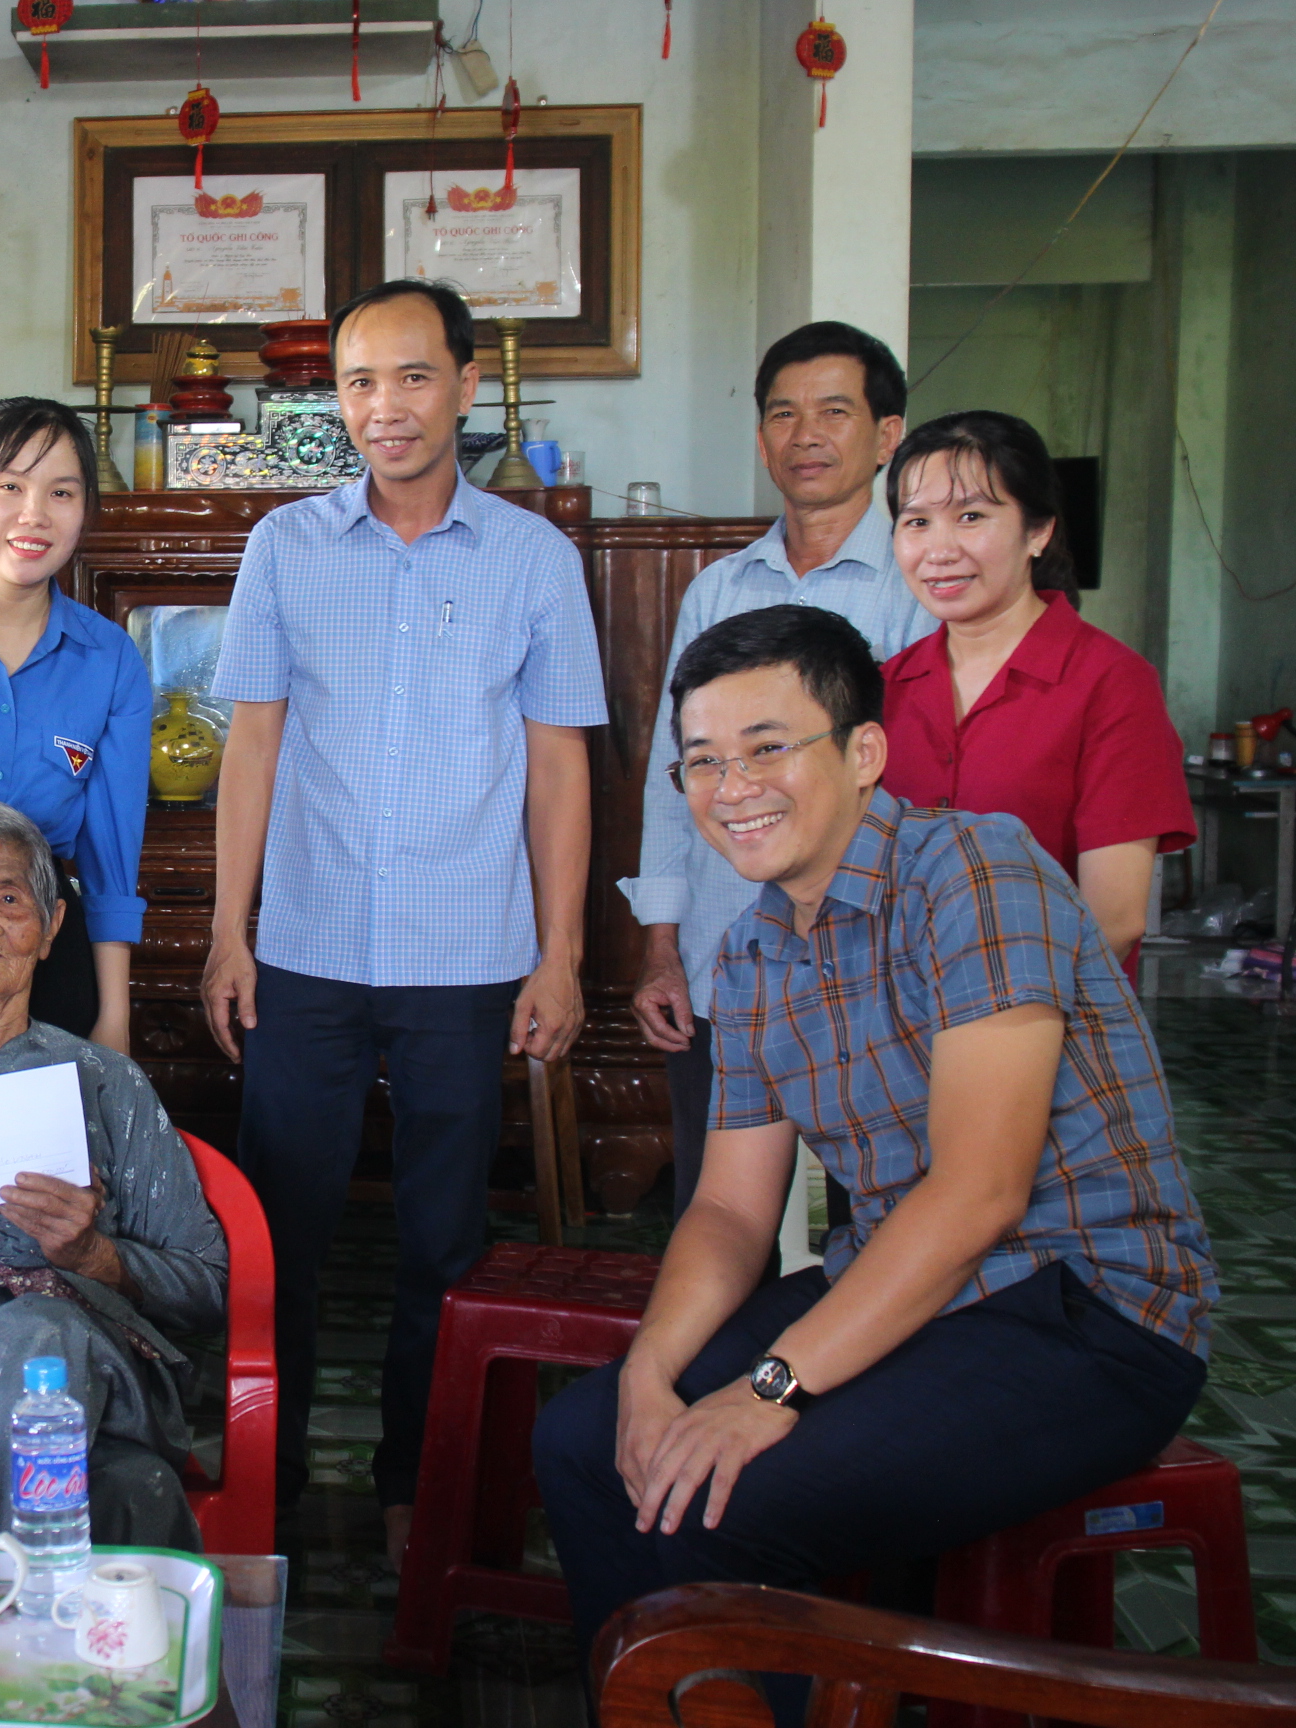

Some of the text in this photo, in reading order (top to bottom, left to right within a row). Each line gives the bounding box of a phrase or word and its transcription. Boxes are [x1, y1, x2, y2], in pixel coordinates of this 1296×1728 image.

[197, 231, 227, 243] QUỐC
[229, 232, 247, 242] GHI
[249, 231, 279, 242] CÔNG
[450, 226, 480, 237] QUỐC
[482, 226, 501, 235] GHI
[19, 1461, 60, 1505] Lộc
